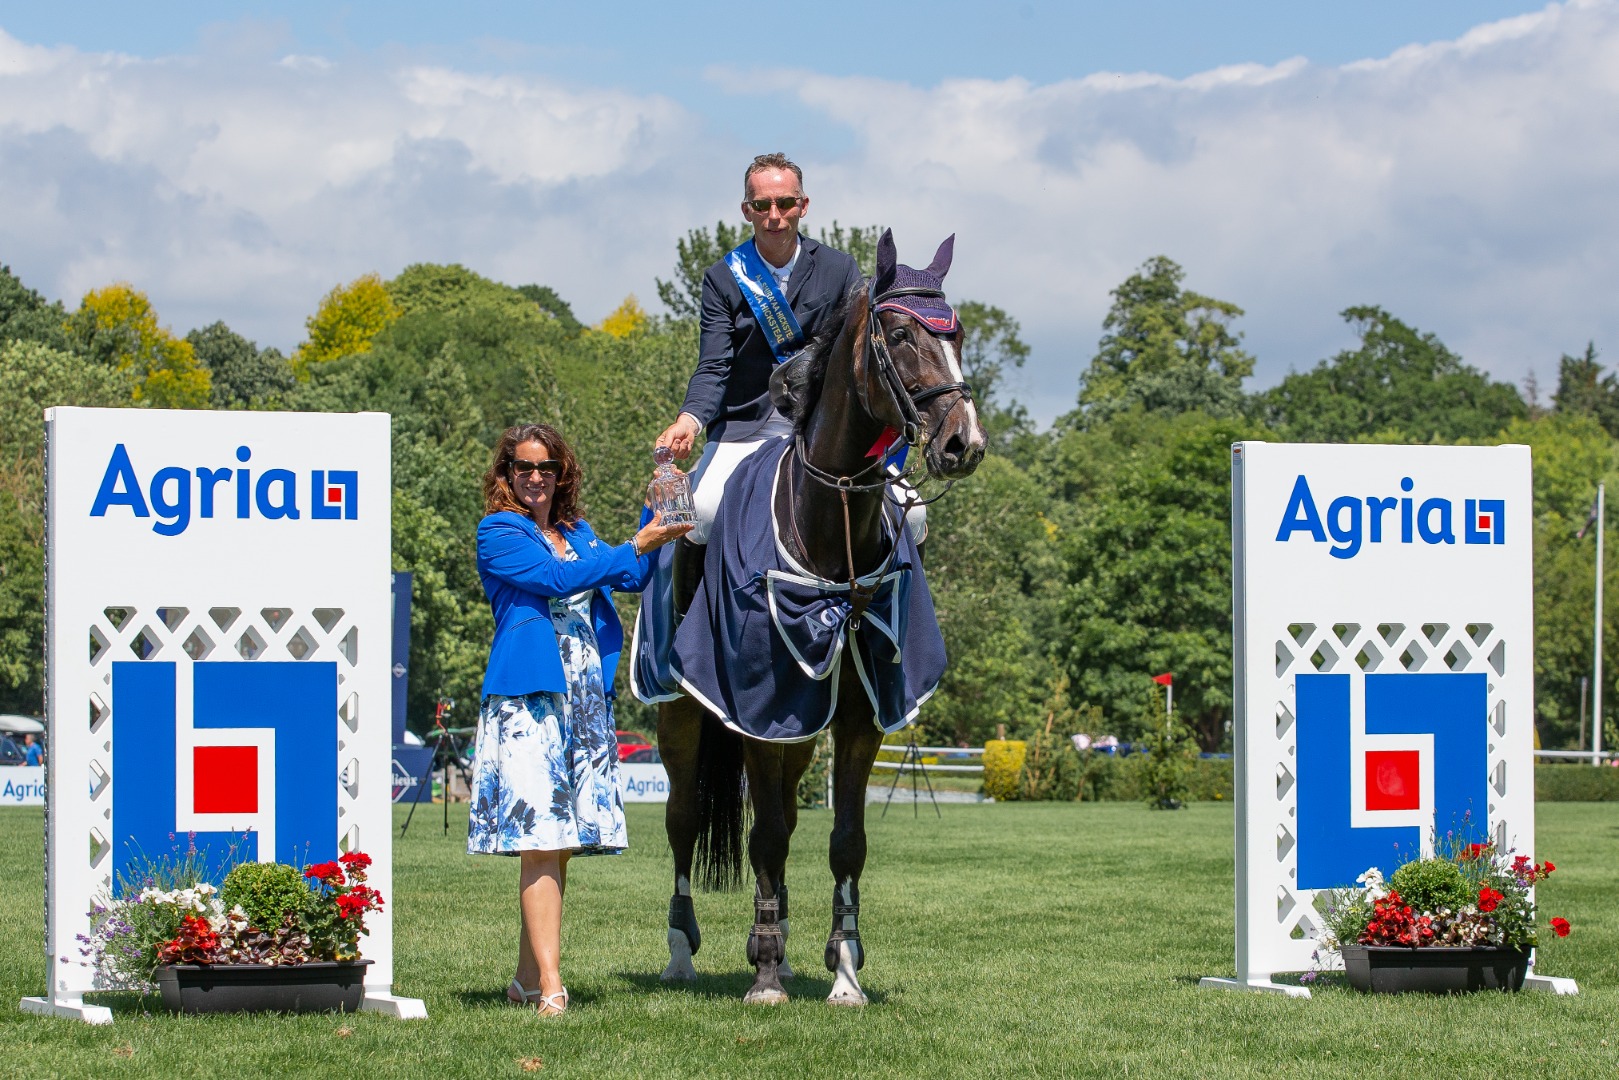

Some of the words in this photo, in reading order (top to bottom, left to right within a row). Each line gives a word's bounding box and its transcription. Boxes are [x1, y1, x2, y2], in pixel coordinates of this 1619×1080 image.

[760, 302, 785, 344] HICKSTEAD
[776, 310, 795, 342] HICKSTEA
[89, 443, 301, 537] Agria
[1275, 474, 1456, 560] Agria
[804, 602, 852, 641] Agri
[626, 775, 665, 797] Agria
